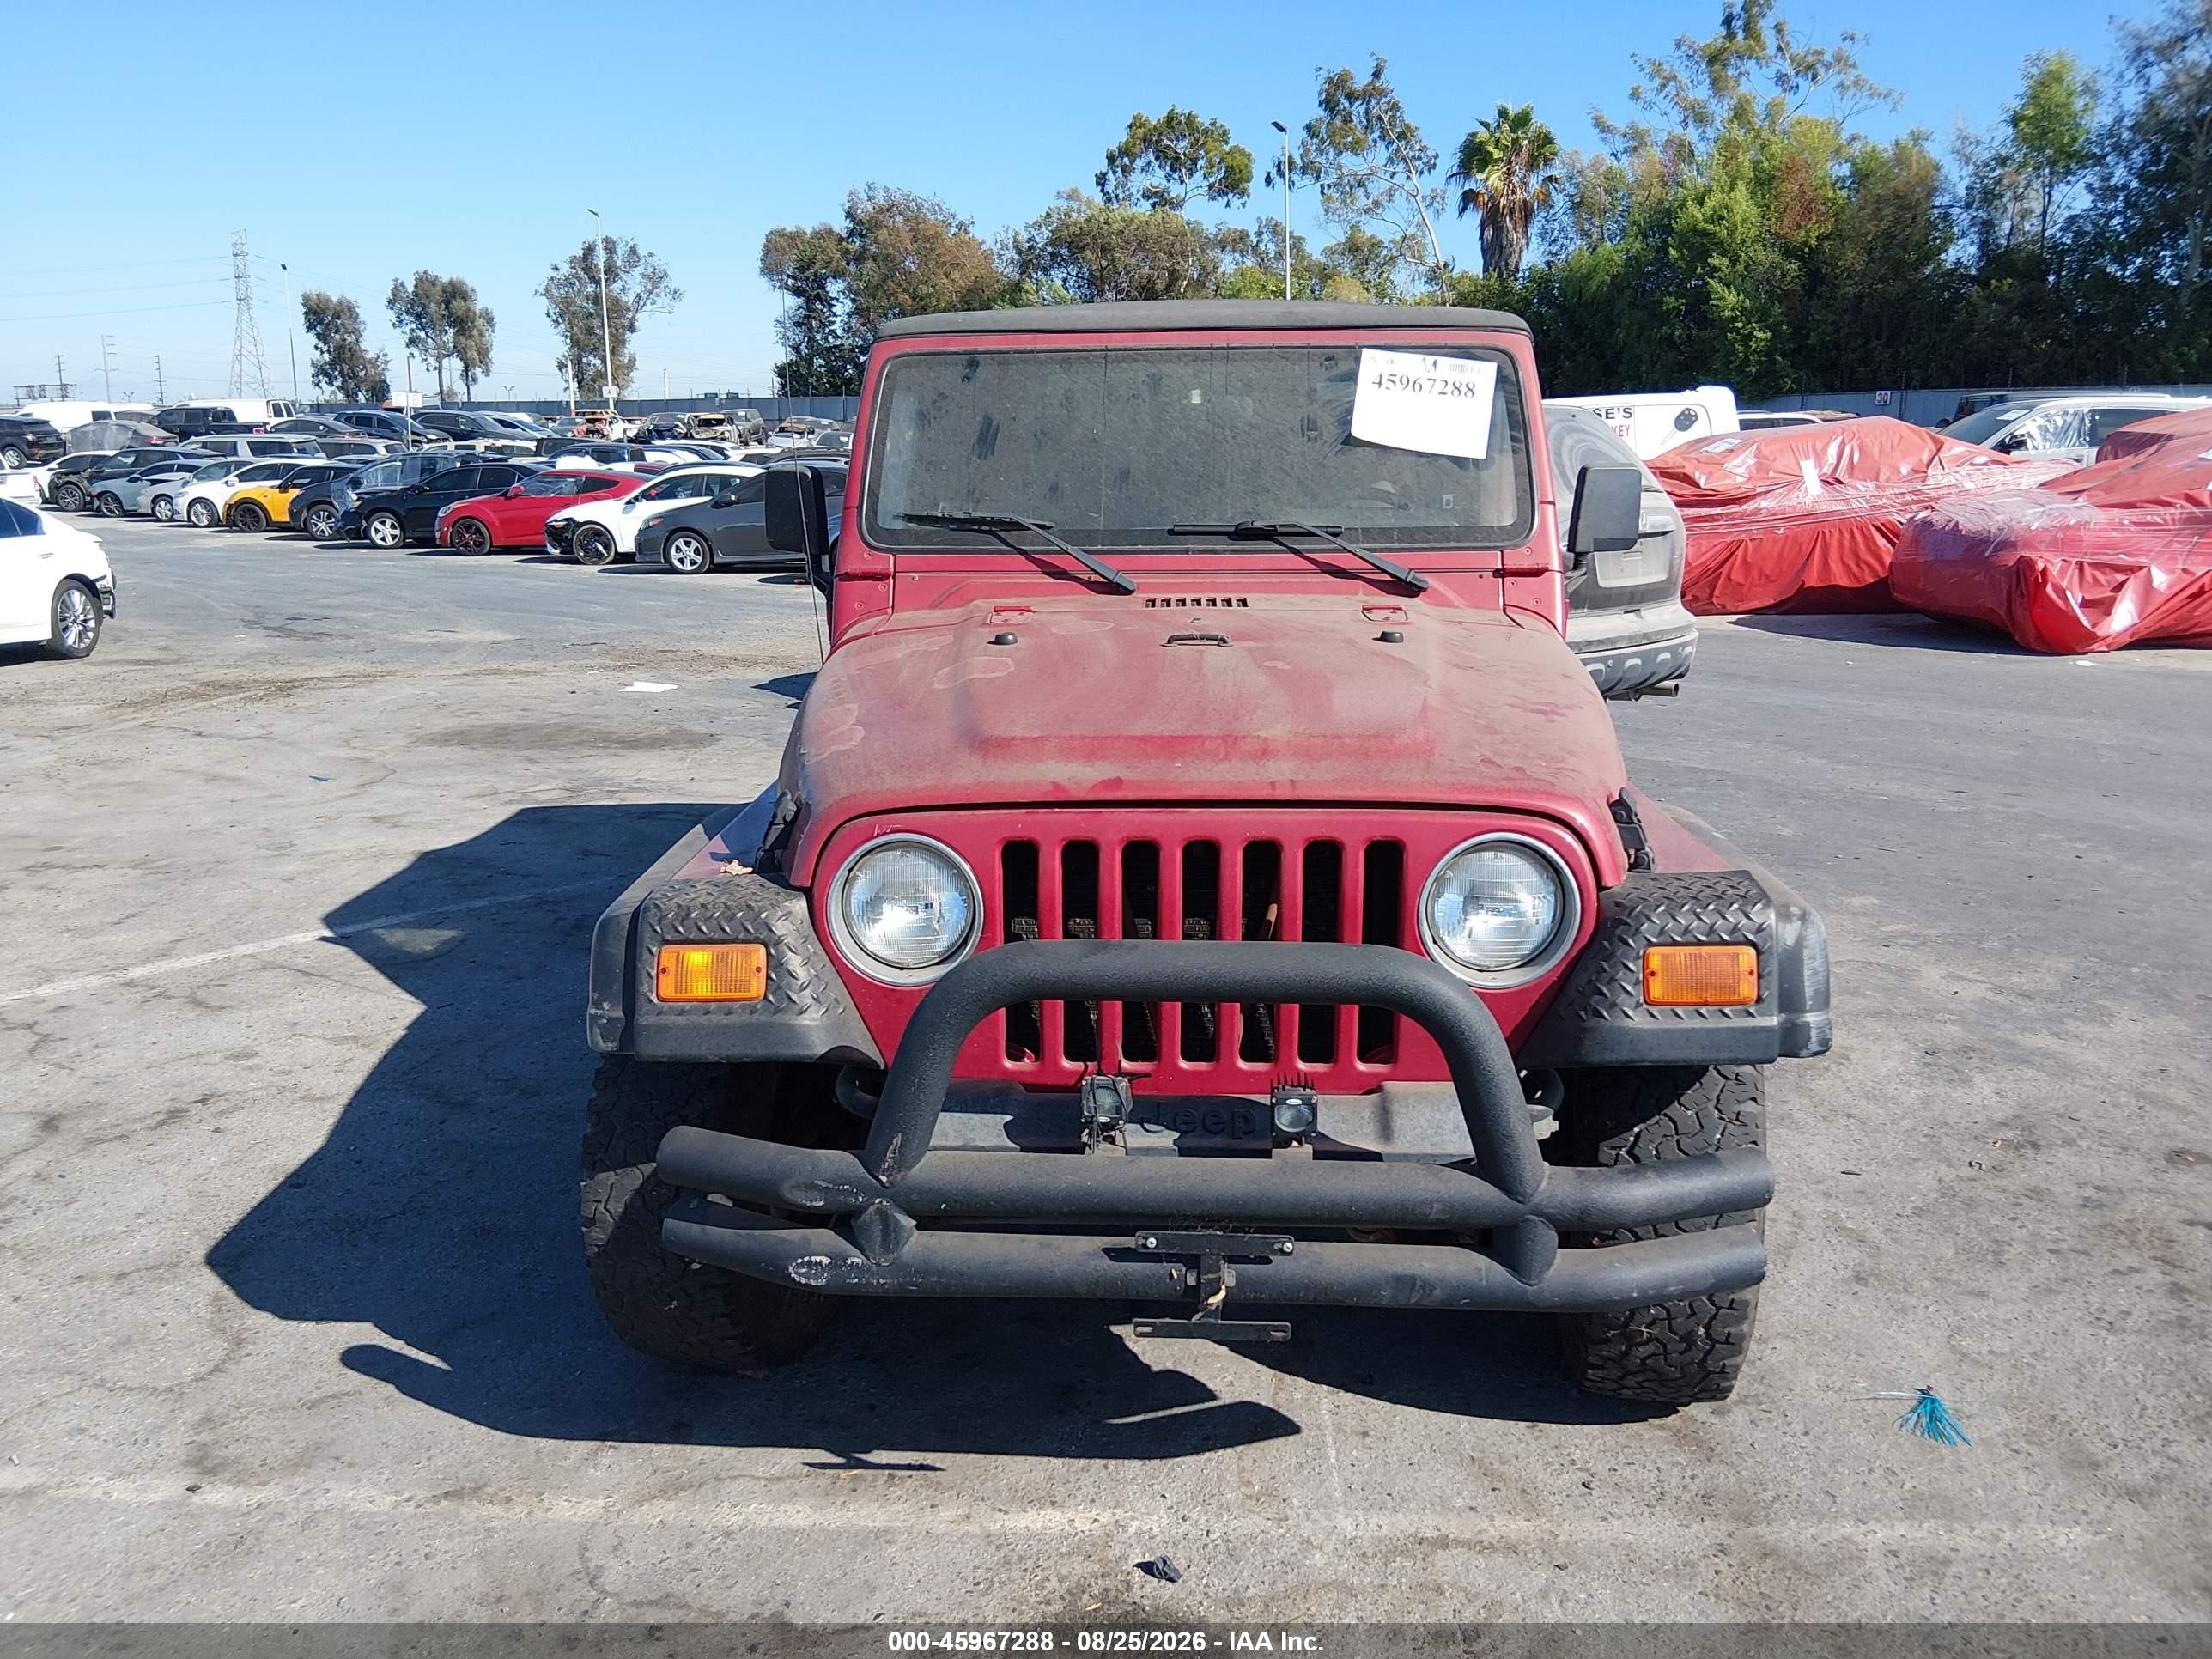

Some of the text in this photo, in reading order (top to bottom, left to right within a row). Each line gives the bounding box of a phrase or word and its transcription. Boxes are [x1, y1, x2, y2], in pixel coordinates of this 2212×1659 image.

[1371, 372, 1476, 398] 45967288
[1876, 392, 1889, 404] 30
[1140, 1101, 1257, 1140] Jeep
